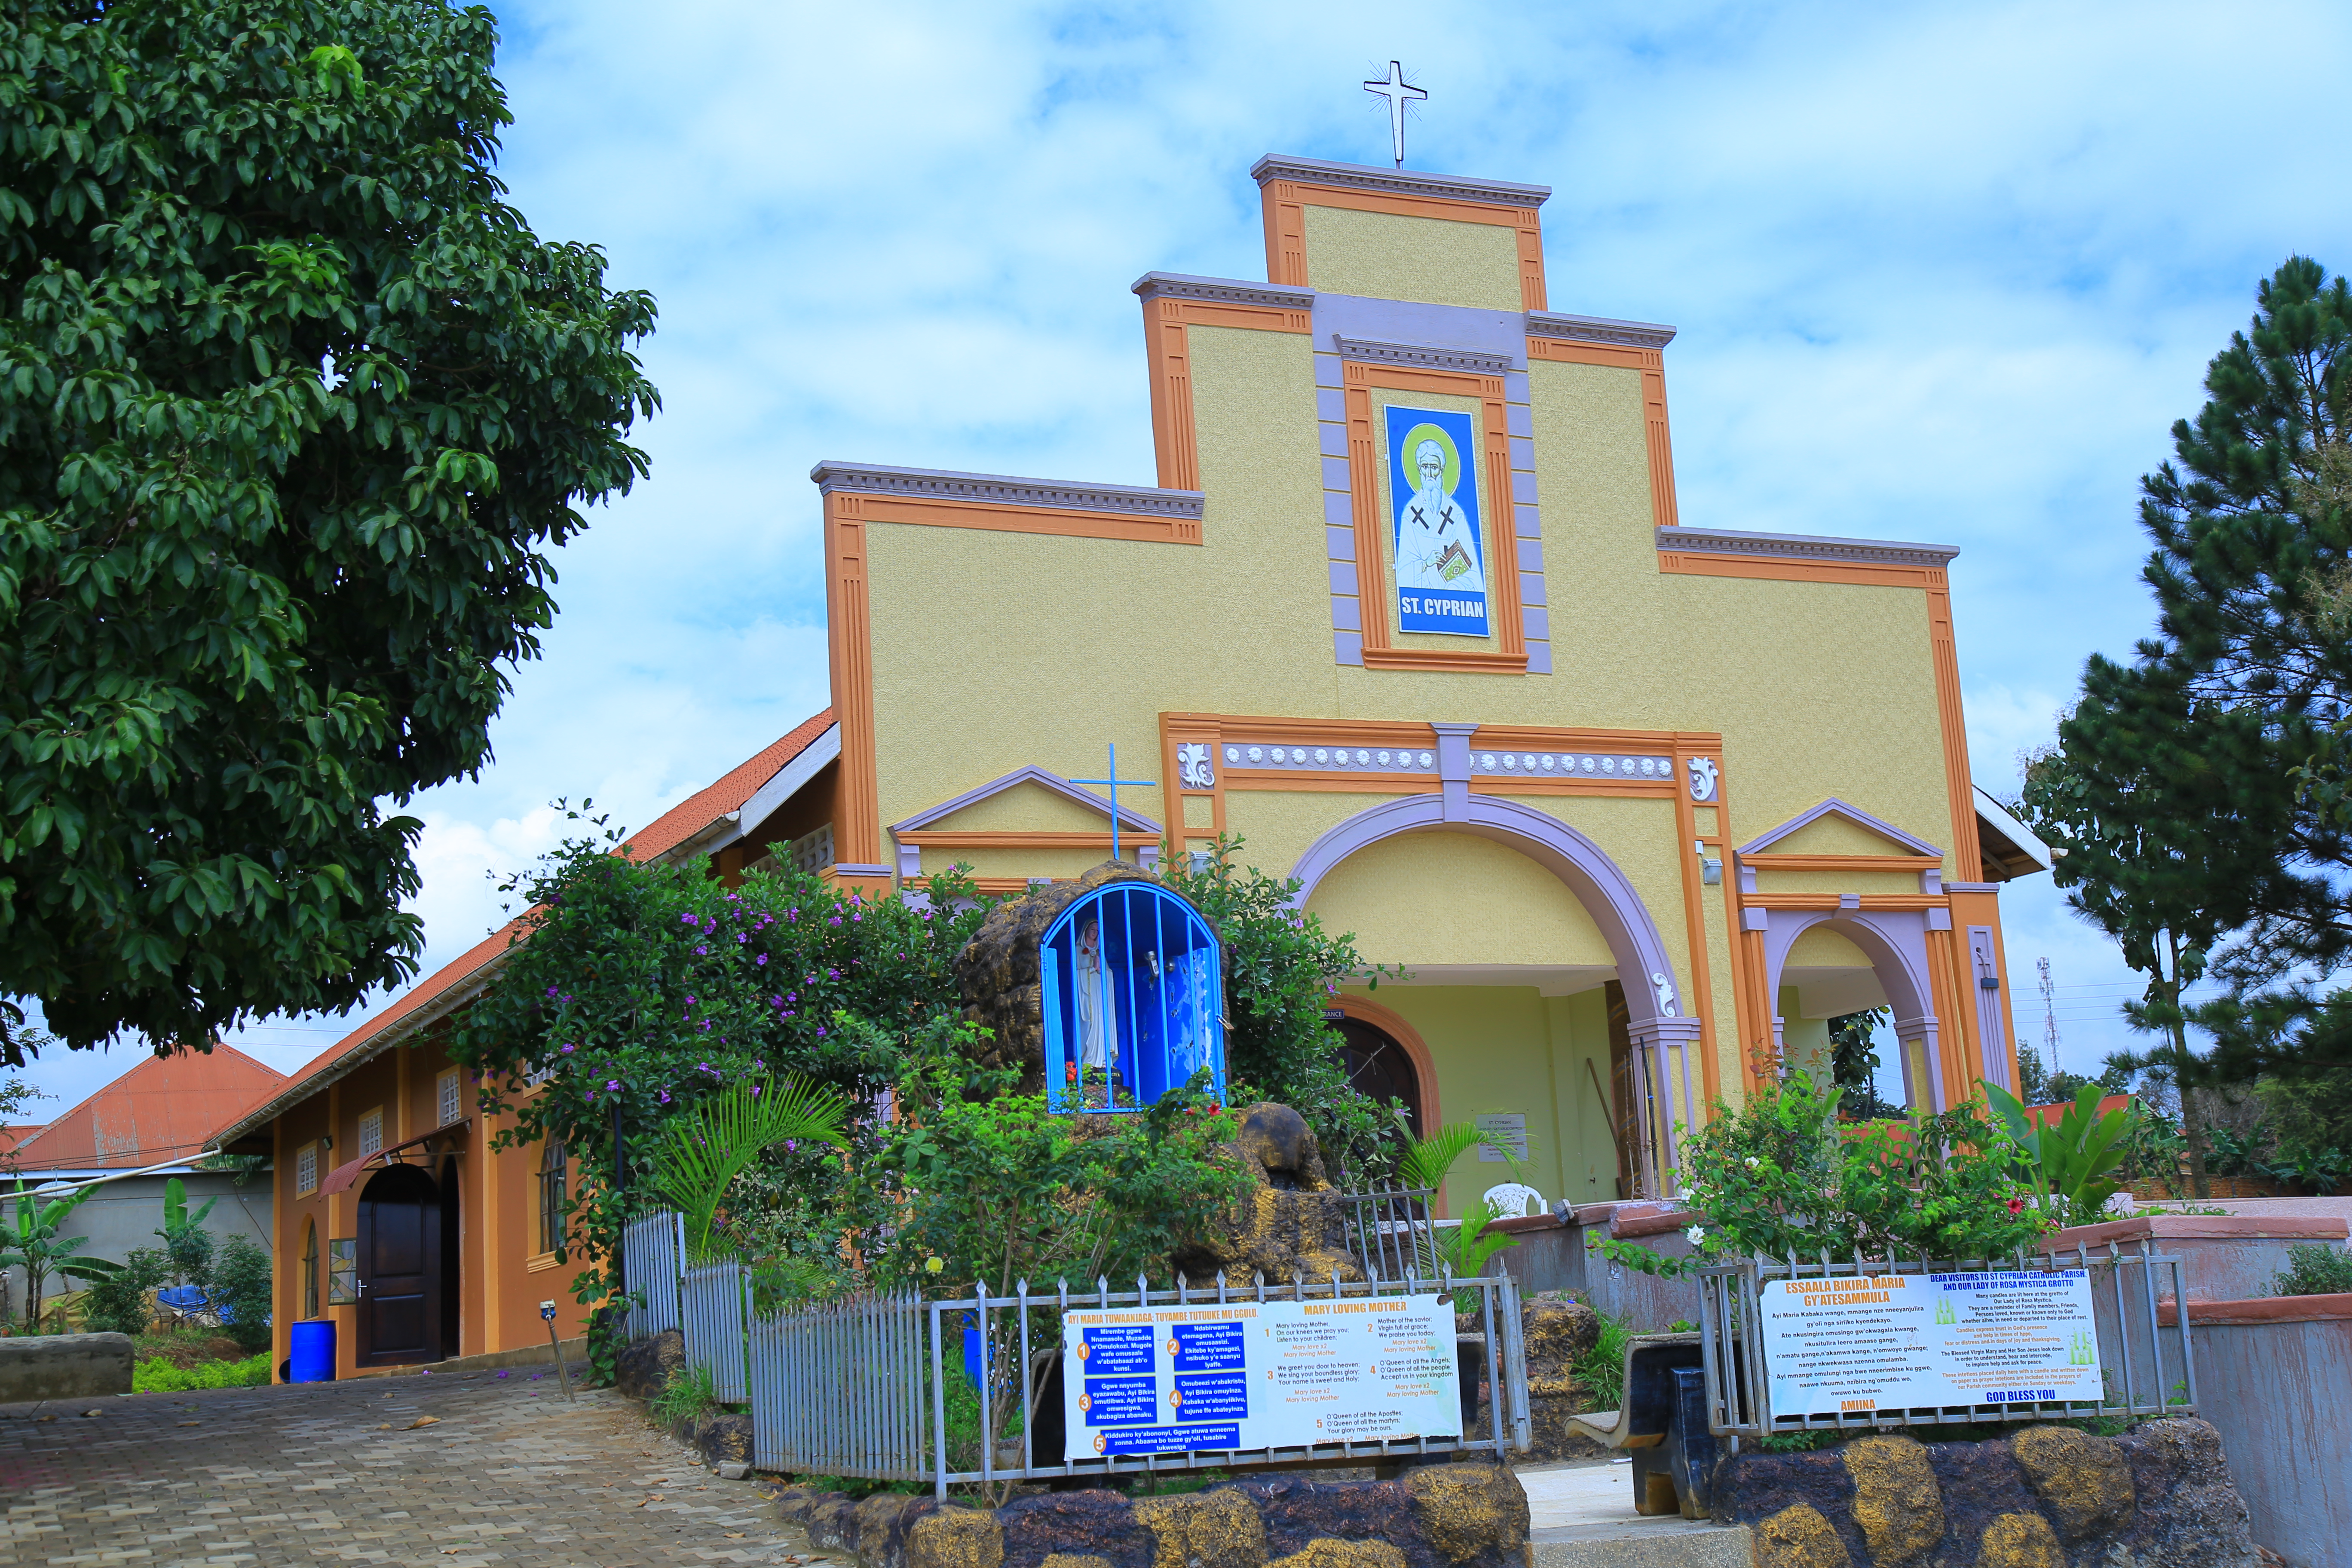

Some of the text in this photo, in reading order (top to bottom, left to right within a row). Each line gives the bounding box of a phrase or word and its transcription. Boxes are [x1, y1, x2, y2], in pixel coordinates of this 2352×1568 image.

[1402, 597, 1484, 618] ST. CYPRIAN
[1930, 1274, 1948, 1283] DEAR
[1948, 1273, 1979, 1282] VISITORS
[2000, 1272, 2028, 1280] CYPRIAN
[1785, 1277, 1905, 1293] ESSAALA BIKIRA MARIA
[1958, 1282, 1972, 1290] OUR
[2048, 1279, 2073, 1287] GROTTO
[1804, 1291, 1890, 1306] GY'ATESAMMULA
[1304, 1302, 1406, 1315] MARY LOVING MOTHER
[1068, 1308, 1258, 1324] AYI MARIA TUWAANJAGA; TUYAMBE TUTUUKE MU GGULU.
[1265, 1328, 1269, 1337] 1
[1367, 1323, 1373, 1332] 2
[1855, 1327, 1893, 1335] gw'okwagala
[1080, 1345, 1086, 1357] 1
[1169, 1341, 1178, 1354] 2
[1207, 1345, 1240, 1354] ky'amagezi,
[1170, 1393, 1179, 1405] 4
[1986, 1389, 2055, 1402] GOD BLESS YOU
[1841, 1399, 1875, 1411] AMIINA
